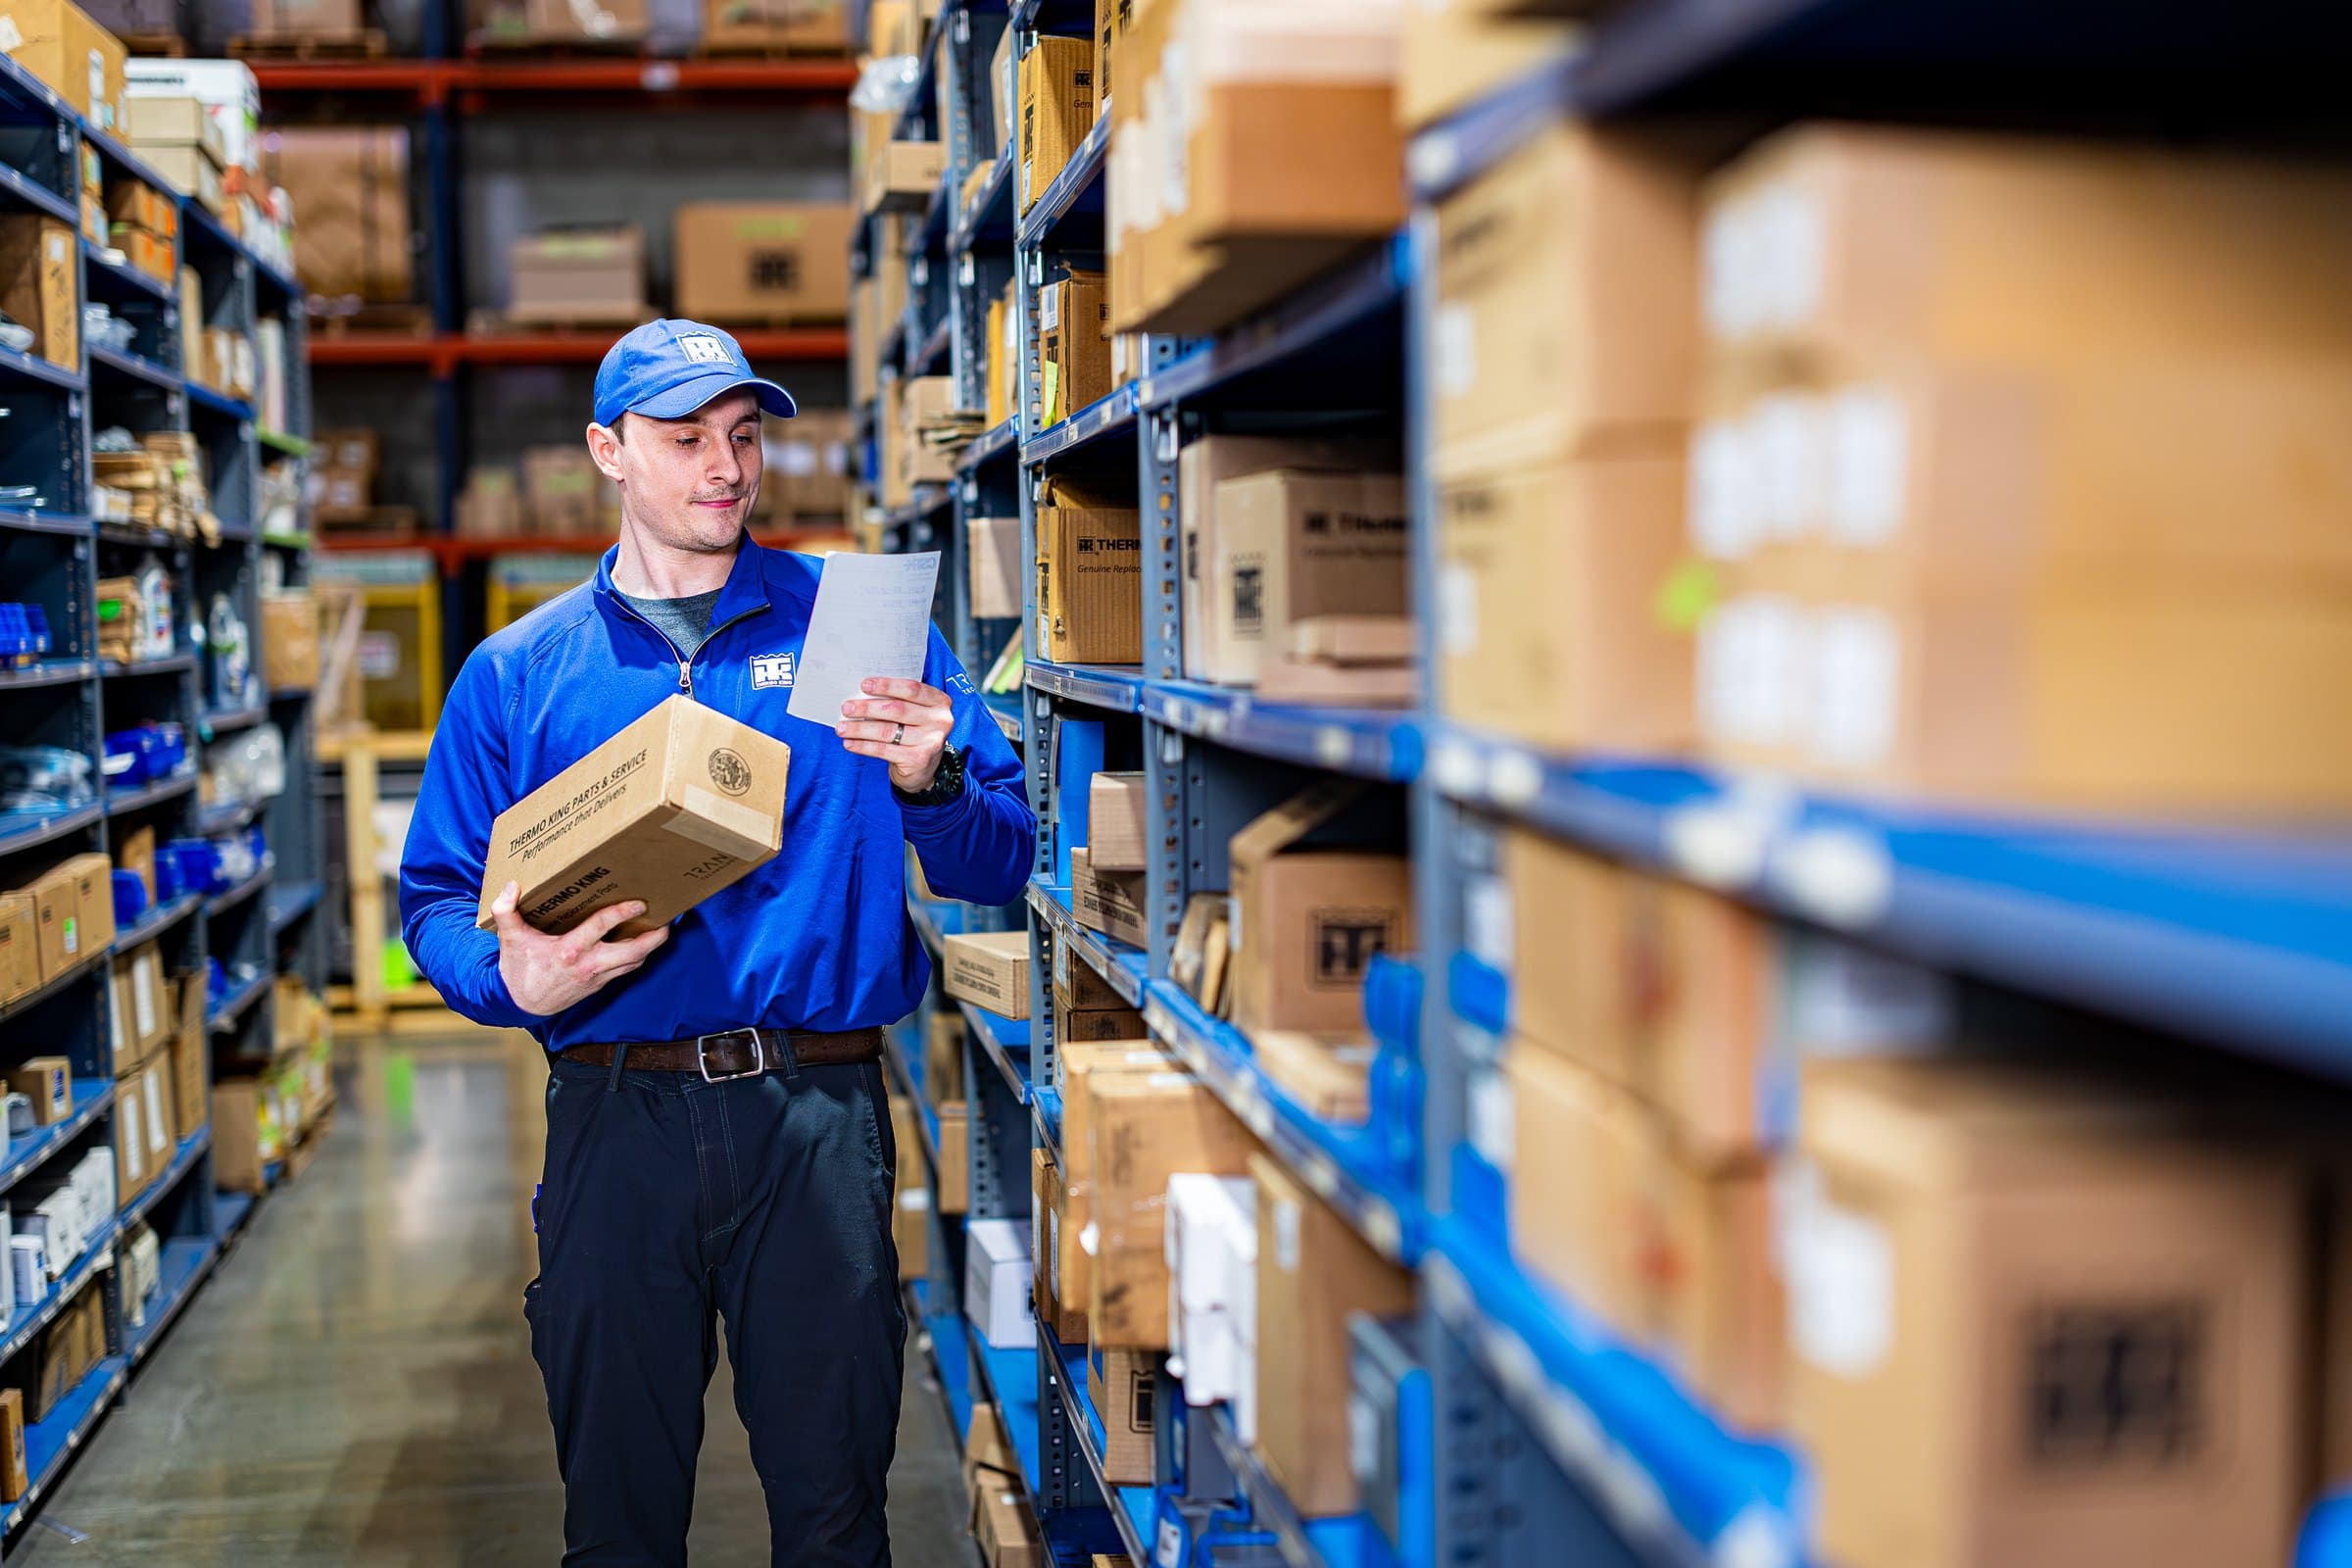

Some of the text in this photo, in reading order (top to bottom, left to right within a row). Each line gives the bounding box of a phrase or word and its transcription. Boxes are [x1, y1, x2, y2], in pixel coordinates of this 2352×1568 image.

[1078, 564, 1110, 573] Genuine
[946, 673, 969, 688] TR
[509, 749, 647, 852] THERMO KING PARTS & SERVICE
[522, 784, 627, 862] Performance that Delivers
[528, 866, 612, 919] THERMO KING
